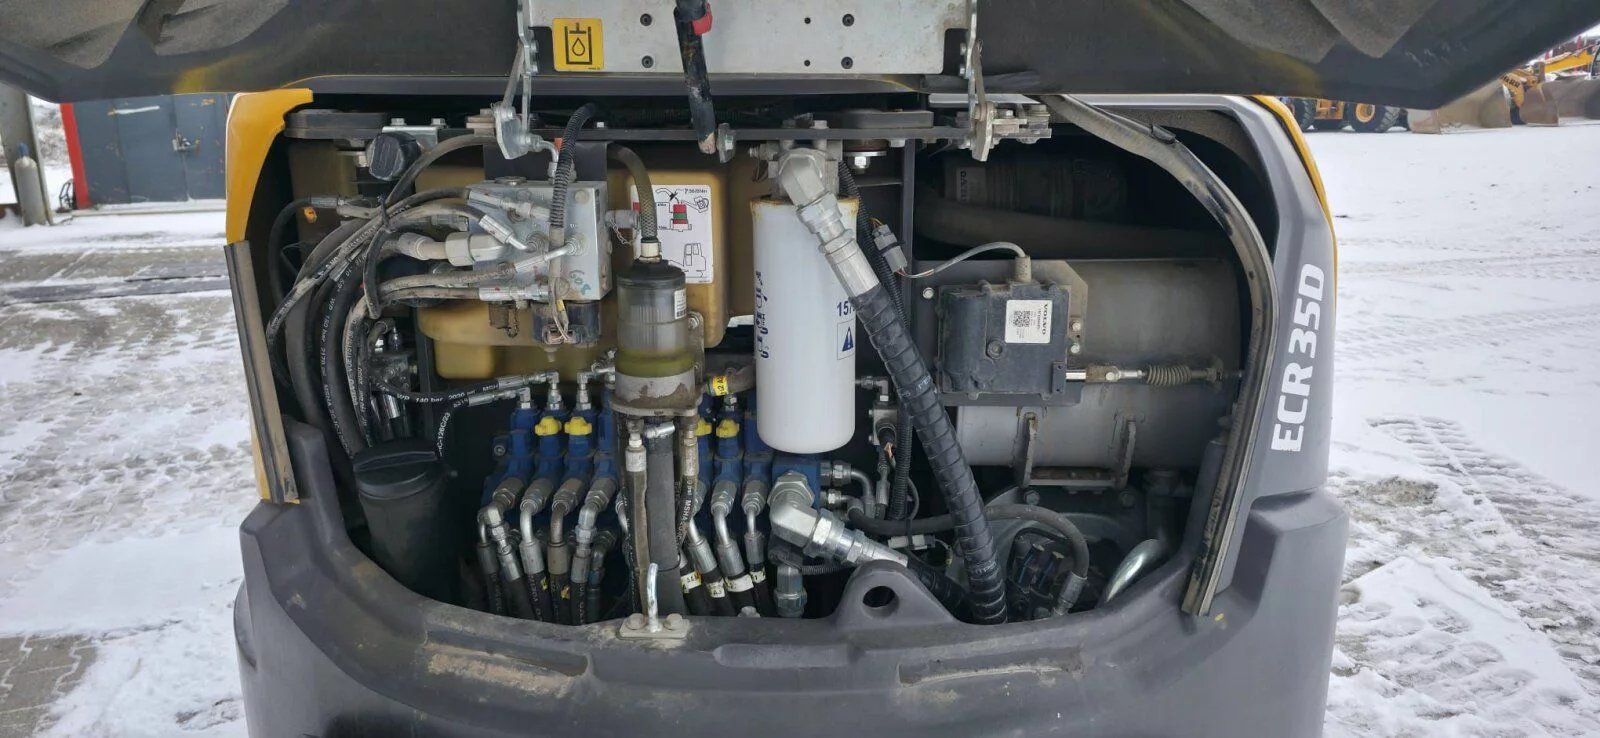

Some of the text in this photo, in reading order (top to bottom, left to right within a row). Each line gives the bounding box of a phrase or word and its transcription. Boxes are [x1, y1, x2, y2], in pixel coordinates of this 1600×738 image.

[397, 393, 410, 402] WP
[415, 396, 428, 404] 140
[684, 500, 692, 522] MSHA
